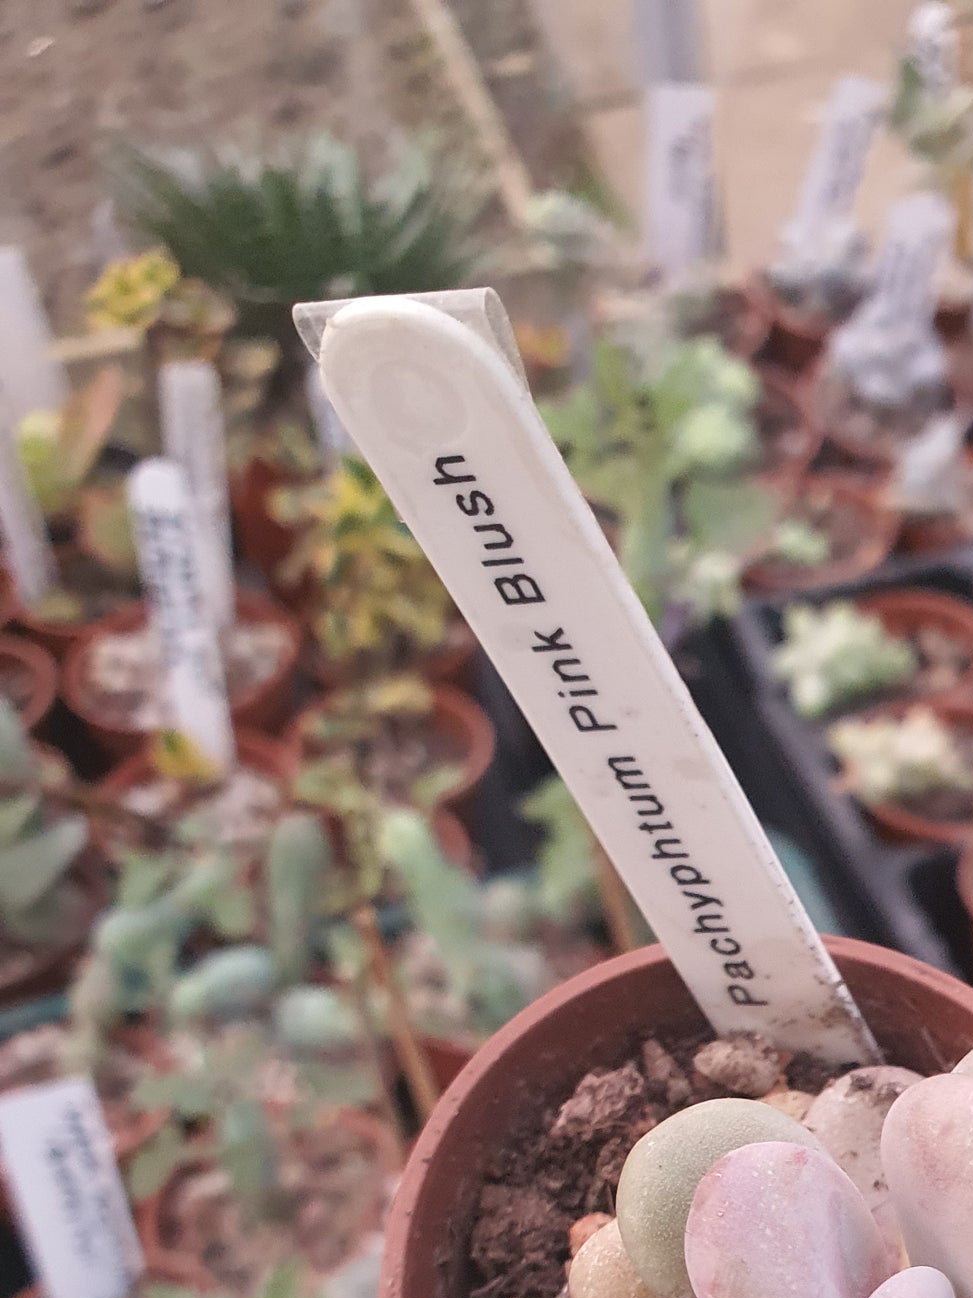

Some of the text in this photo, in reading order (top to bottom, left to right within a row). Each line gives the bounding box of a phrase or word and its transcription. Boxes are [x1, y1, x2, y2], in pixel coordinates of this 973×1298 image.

[432, 454, 769, 1007] Pachyphtum Pink Blush
